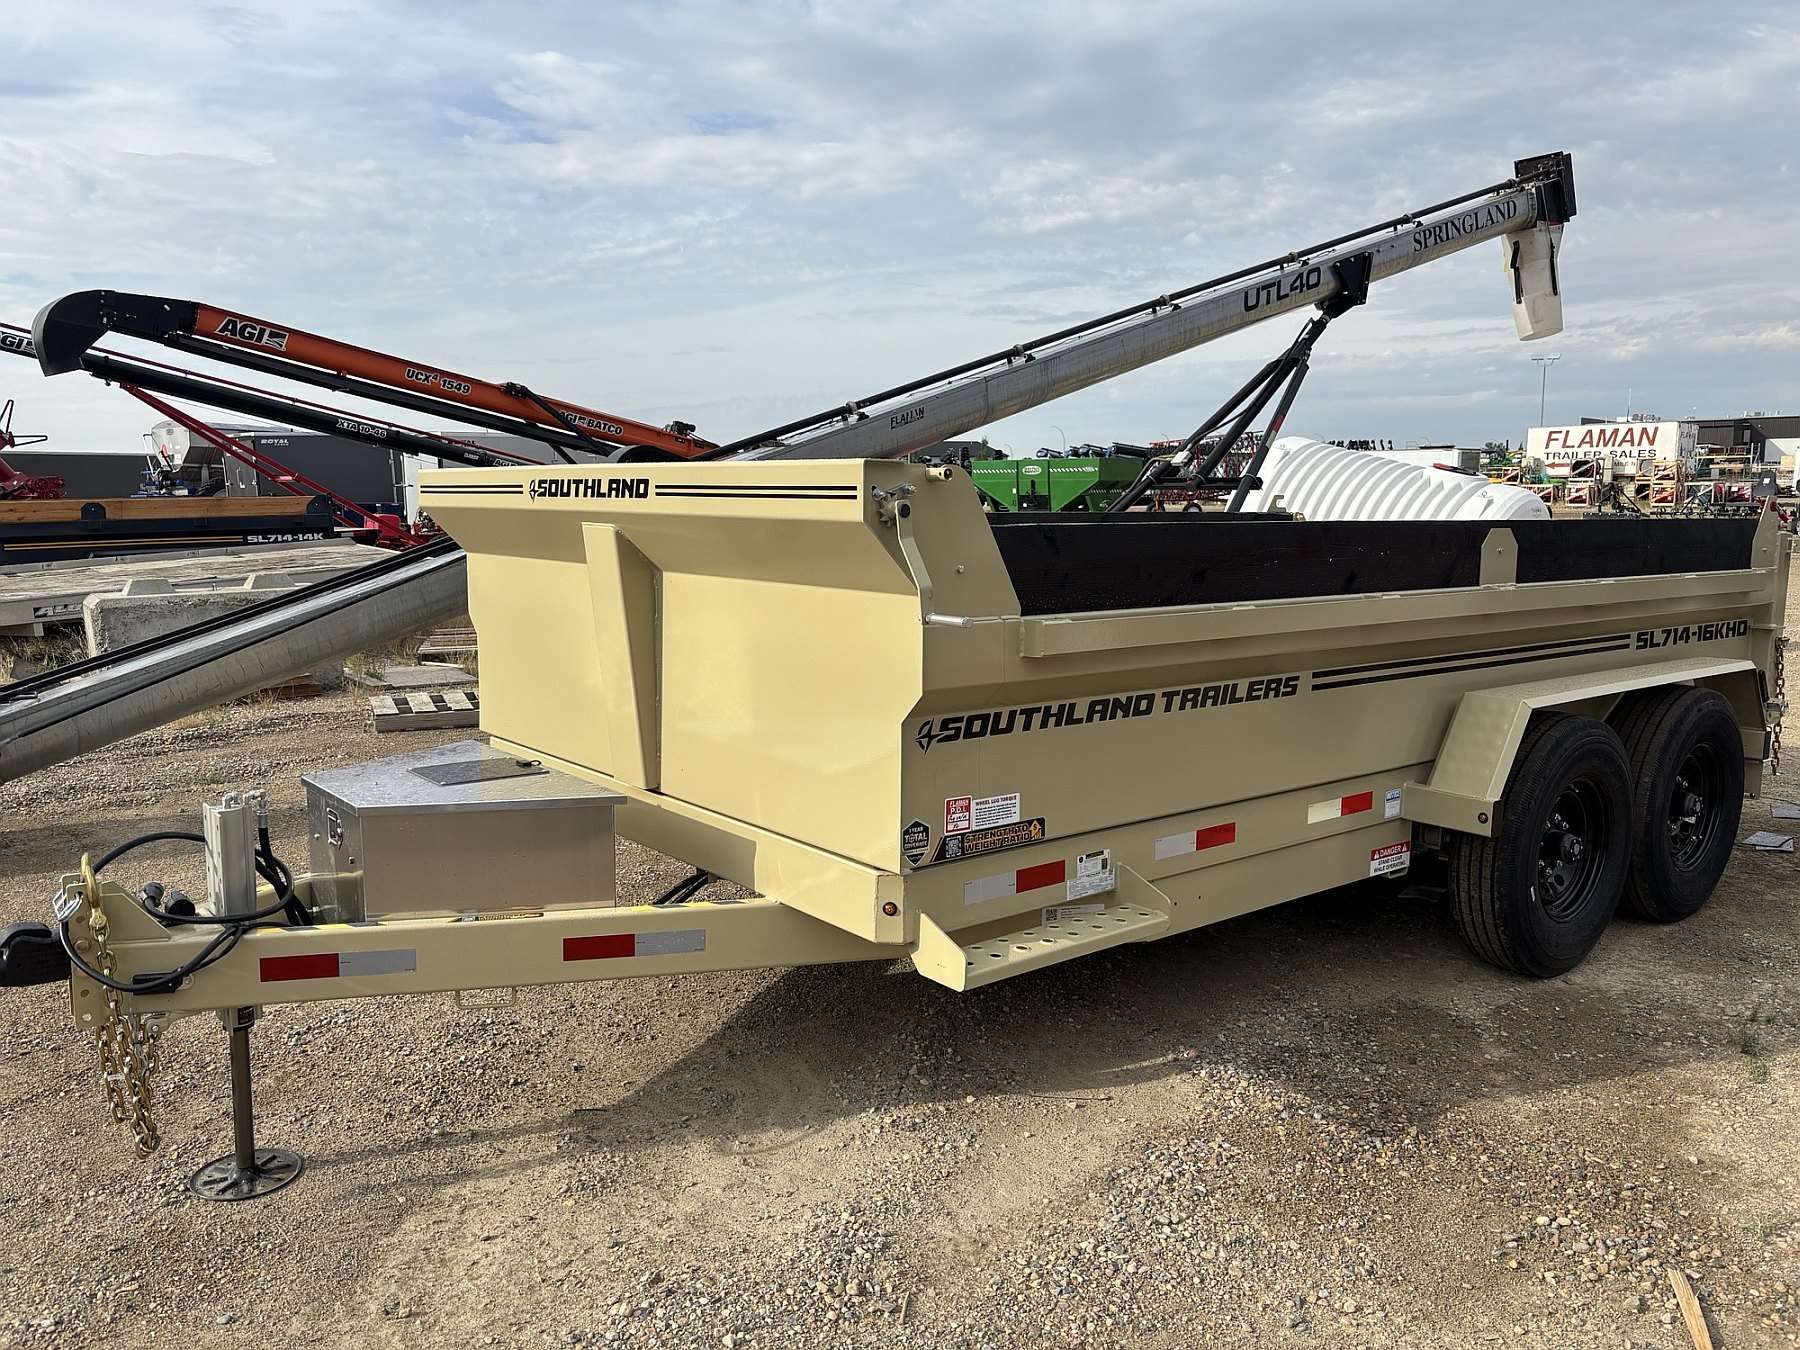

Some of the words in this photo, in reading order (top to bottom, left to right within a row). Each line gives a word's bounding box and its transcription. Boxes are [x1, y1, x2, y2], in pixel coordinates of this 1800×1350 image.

[1412, 199, 1517, 251] SPRINGLAND
[1243, 267, 1321, 312] UTL40
[214, 316, 267, 345] AGI
[0, 334, 25, 350] GI
[441, 377, 472, 395] 1549
[336, 418, 358, 432] XTA
[359, 424, 387, 438] 10-46
[587, 418, 624, 436] BATCO
[1545, 426, 1659, 449] FLAMAN
[1544, 451, 1602, 460] TRAILER
[1610, 449, 1657, 459] SALES
[537, 478, 650, 499] SOUTHLAND
[247, 532, 323, 542] SL714-14K
[936, 693, 1156, 743] SOUTHLAND
[1161, 675, 1300, 713] TRAILERS
[904, 832, 928, 843] TOTAL
[965, 826, 1014, 843] STRENGTH
[965, 838, 1003, 853] WEIGHT
[1379, 845, 1402, 858] DANGER
